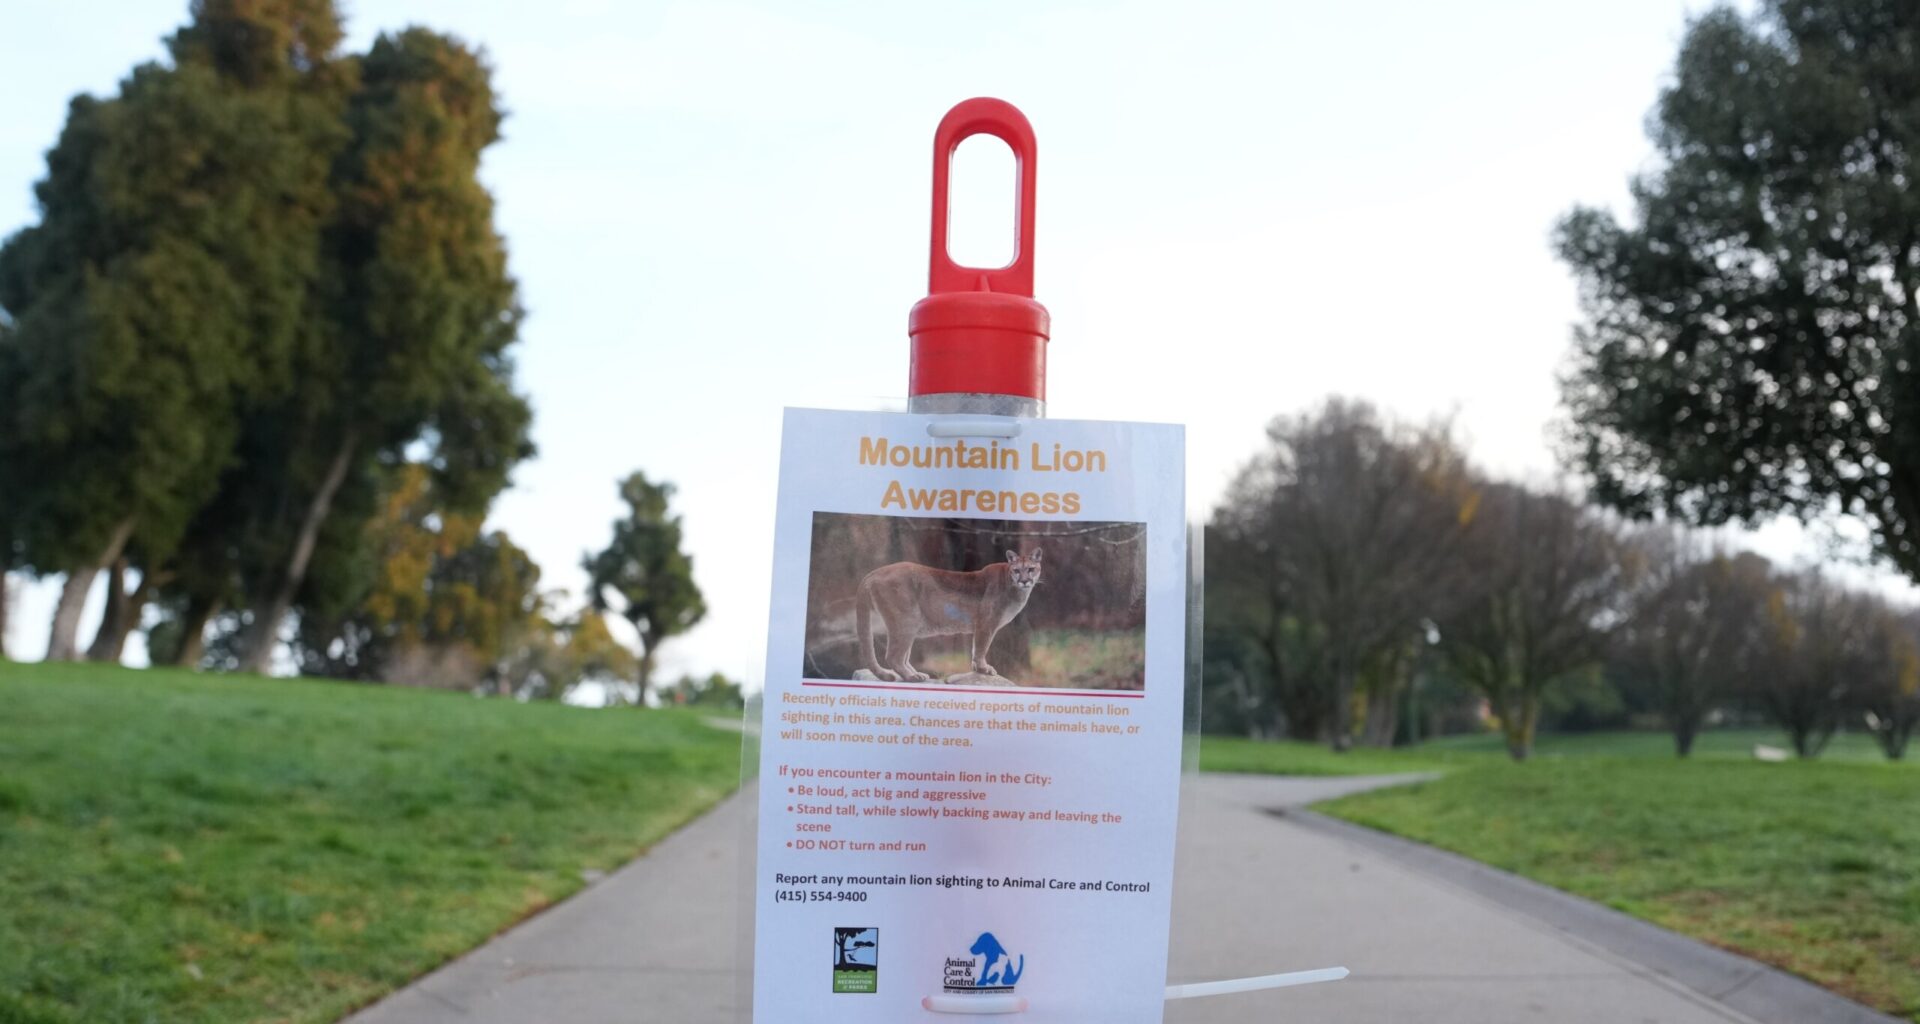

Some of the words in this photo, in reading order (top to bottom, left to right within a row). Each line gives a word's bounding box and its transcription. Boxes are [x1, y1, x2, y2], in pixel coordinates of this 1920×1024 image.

[860, 436, 1019, 470] Mountain
[1032, 442, 1106, 472] Lion
[881, 479, 1080, 513] Awareness
[782, 693, 835, 707] Recently
[839, 694, 887, 707] officials
[891, 697, 920, 708] have
[924, 698, 976, 711] received
[979, 700, 1025, 716] reports
[1029, 701, 1041, 712] of
[1044, 703, 1103, 715] mountain
[1107, 704, 1129, 716] lion
[781, 711, 830, 725] sighting
[834, 711, 844, 723] in
[849, 713, 872, 724] this
[875, 717, 907, 726] area.
[910, 716, 960, 728] Chances
[964, 720, 984, 729] are
[987, 719, 1013, 730] that
[1016, 720, 1037, 731] the
[1040, 721, 1087, 732] animals
[1091, 722, 1123, 735] have,
[1127, 725, 1140, 734] or
[781, 729, 802, 740] will
[806, 732, 836, 741] soon
[840, 733, 874, 743] move
[877, 734, 899, 744] out
[902, 733, 916, 744] of
[918, 734, 939, 745] the
[942, 738, 972, 747] area.
[779, 765, 788, 776] If
[791, 768, 813, 778] you
[817, 769, 881, 779] encounter
[885, 772, 892, 780] a
[896, 771, 955, 781] mountain
[959, 771, 982, 782] lion
[986, 772, 997, 783] in
[1000, 773, 1021, 783] the
[1024, 773, 1051, 787] City:
[798, 785, 813, 795] Be
[817, 785, 848, 798] loud,
[852, 789, 870, 797] act
[874, 787, 893, 800] big
[896, 789, 919, 798] and
[923, 790, 986, 801] aggressive
[797, 804, 832, 814] Stand
[836, 805, 858, 816] tall,
[863, 806, 896, 816] while
[900, 806, 939, 819] slowly
[943, 807, 989, 820] backing
[992, 810, 1025, 821] away
[1028, 810, 1051, 820] and
[1055, 810, 1099, 824] leaving
[1101, 812, 1122, 823] the
[796, 824, 831, 832] scene
[796, 840, 815, 849] DO
[819, 840, 846, 850] NOT
[849, 841, 875, 850] turn
[879, 840, 902, 851] and
[905, 843, 926, 851] run
[776, 873, 817, 885] Report
[821, 876, 843, 886] any
[847, 875, 906, 885] mountain
[910, 874, 932, 885] lion
[936, 875, 983, 889] sighting
[987, 878, 999, 887] to
[1003, 877, 1045, 888] Animal
[1049, 879, 1076, 889] Care
[1080, 880, 1102, 890] and
[1106, 881, 1150, 892] Control
[775, 890, 806, 903] (415)
[811, 891, 867, 901] 554-9400
[944, 957, 975, 967] Animal
[944, 967, 963, 977] Care
[965, 968, 972, 977] &
[944, 976, 975, 986] Control
